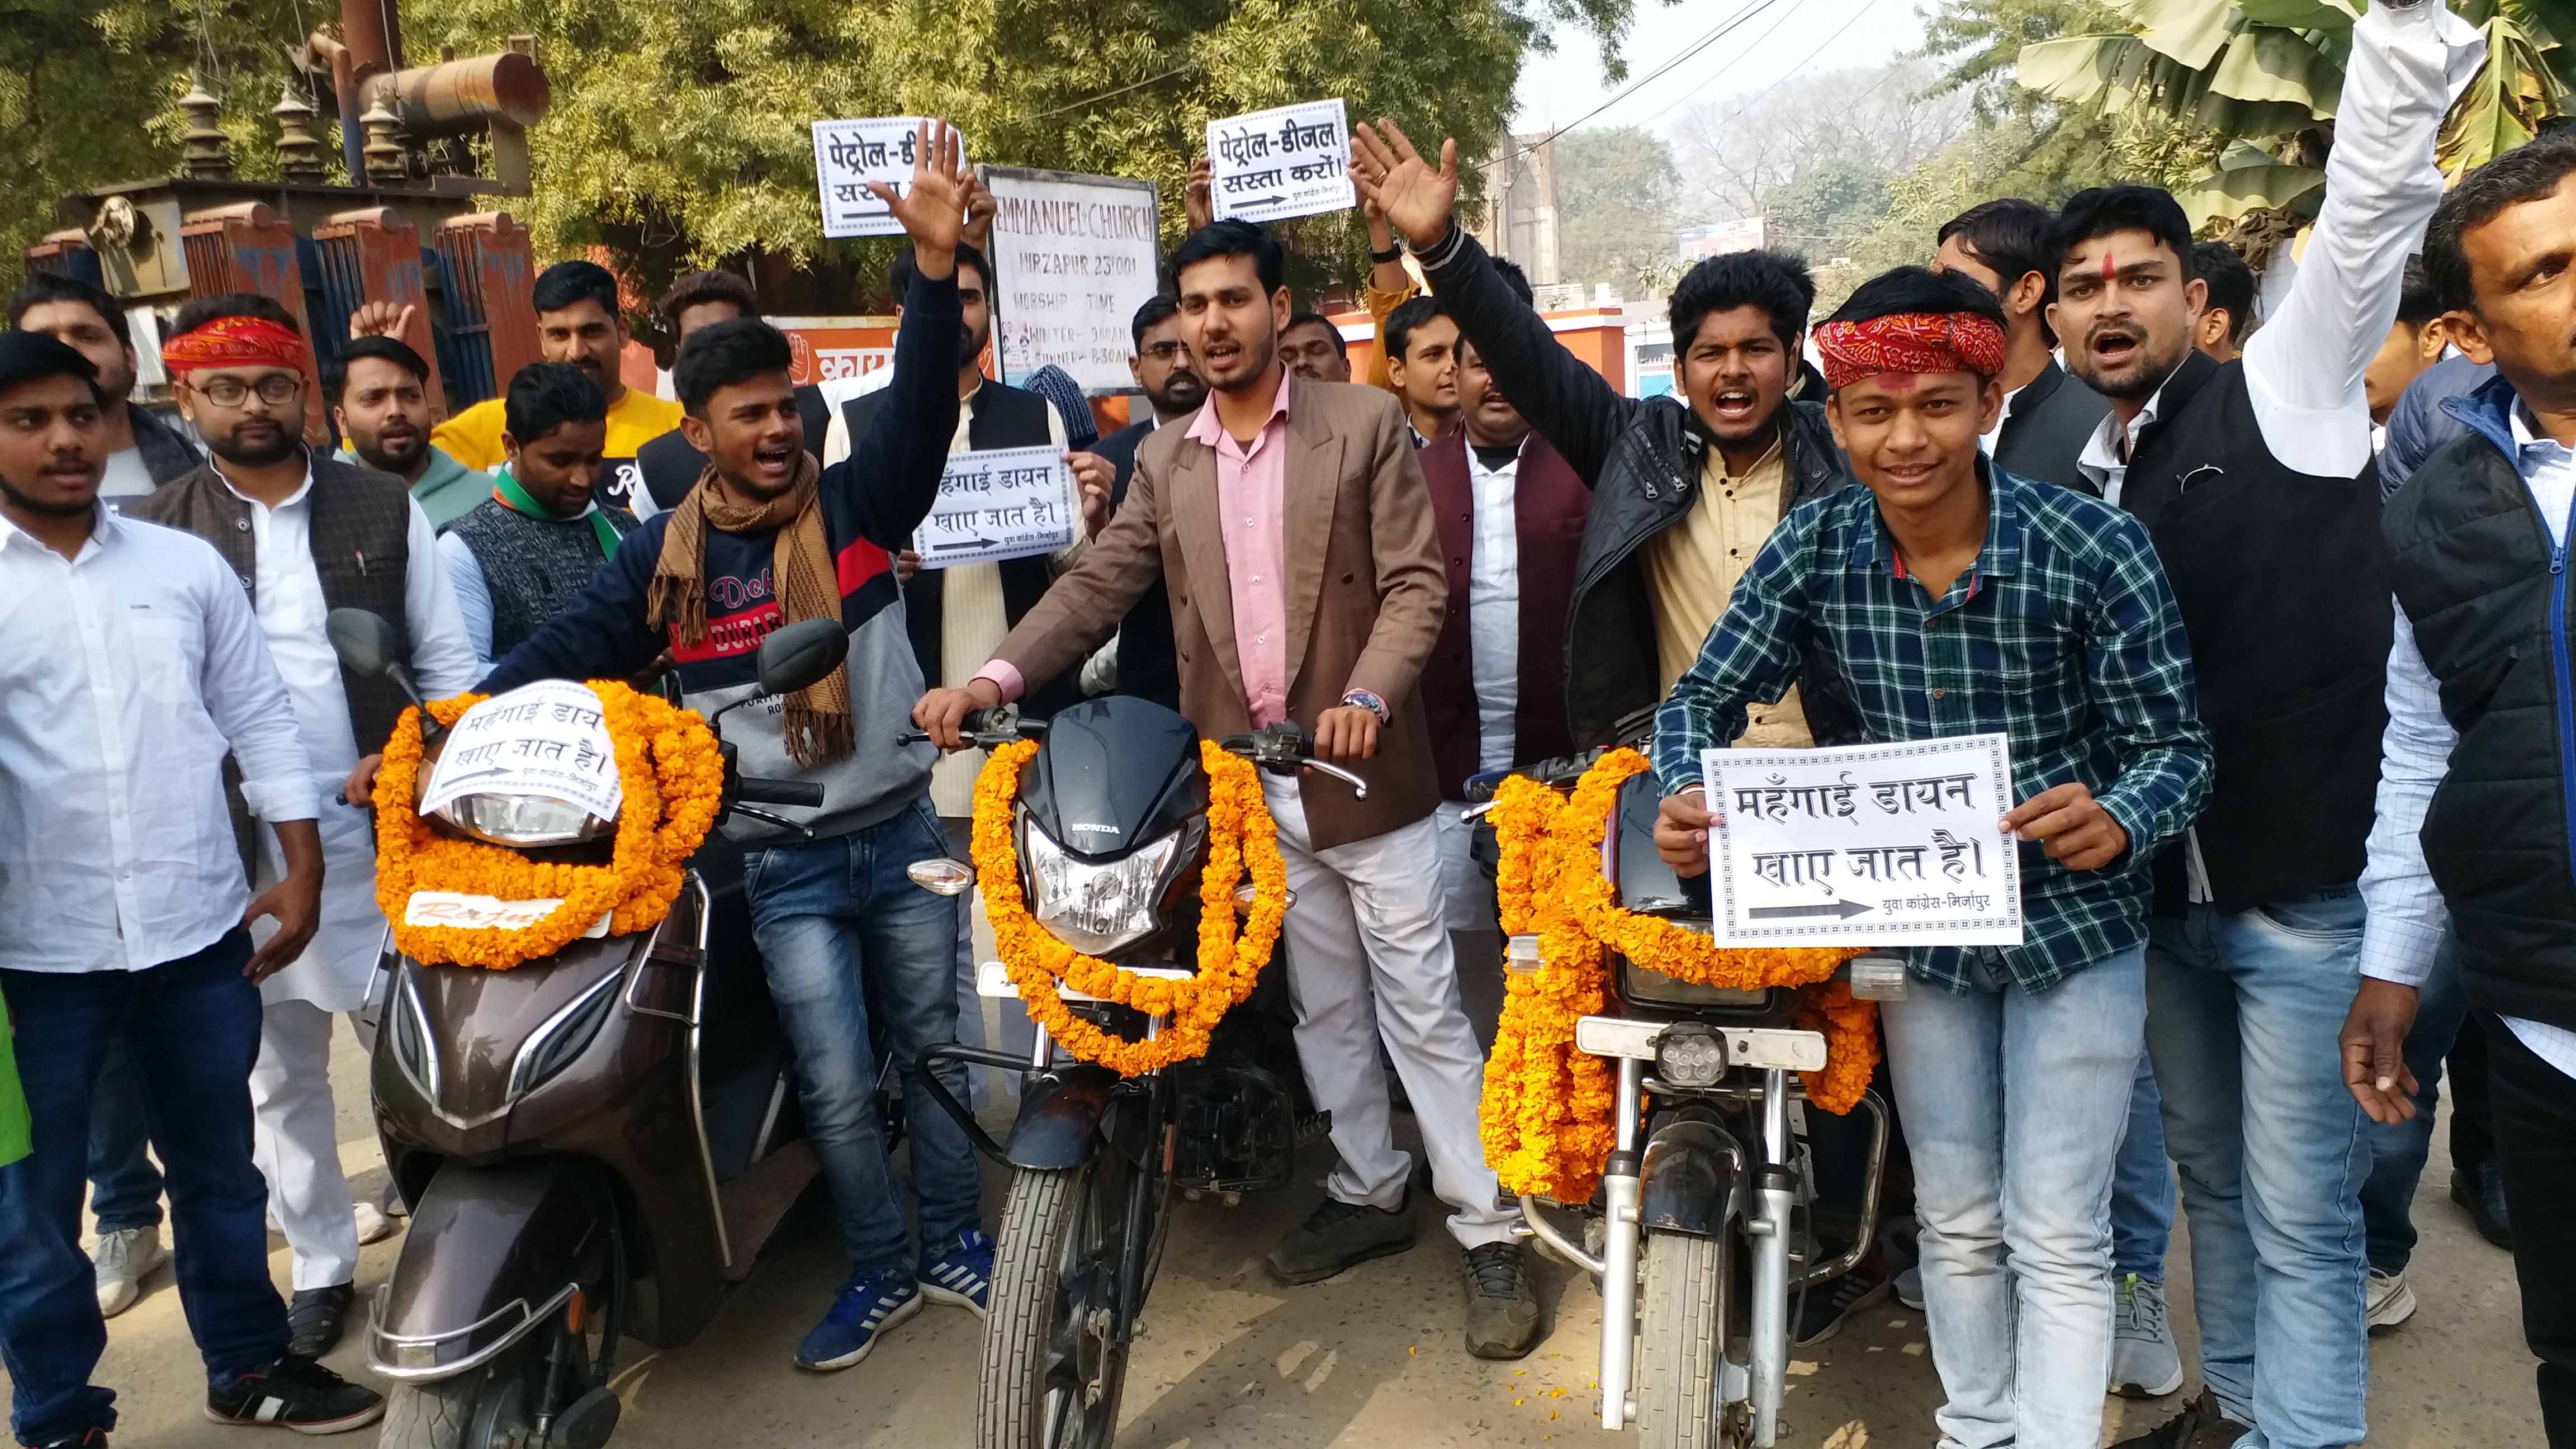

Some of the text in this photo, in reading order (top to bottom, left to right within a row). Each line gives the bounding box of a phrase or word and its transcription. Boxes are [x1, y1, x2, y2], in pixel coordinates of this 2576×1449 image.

[1219, 118, 1337, 167] पेट्रोल-डीजल
[1221, 168, 1284, 193] सस्ता
[995, 196, 1153, 242] EMMANUEL CHURCH
[1019, 252, 1088, 275] MIRZAPUR
[1014, 292, 1115, 313] WORSHIP TIME
[939, 464, 1053, 498] हँगाई डायन
[933, 510, 978, 537] खाए
[984, 505, 1027, 529] जात
[709, 568, 775, 609] Dick
[551, 702, 604, 732] डाय
[455, 740, 508, 766] खाए
[512, 738, 571, 761] जात
[1732, 770, 1978, 827] महँगाई डायन
[1071, 823, 1120, 834] HONDA
[1751, 828, 1987, 897] खाए जात है।
[1882, 899, 1903, 915] युवा
